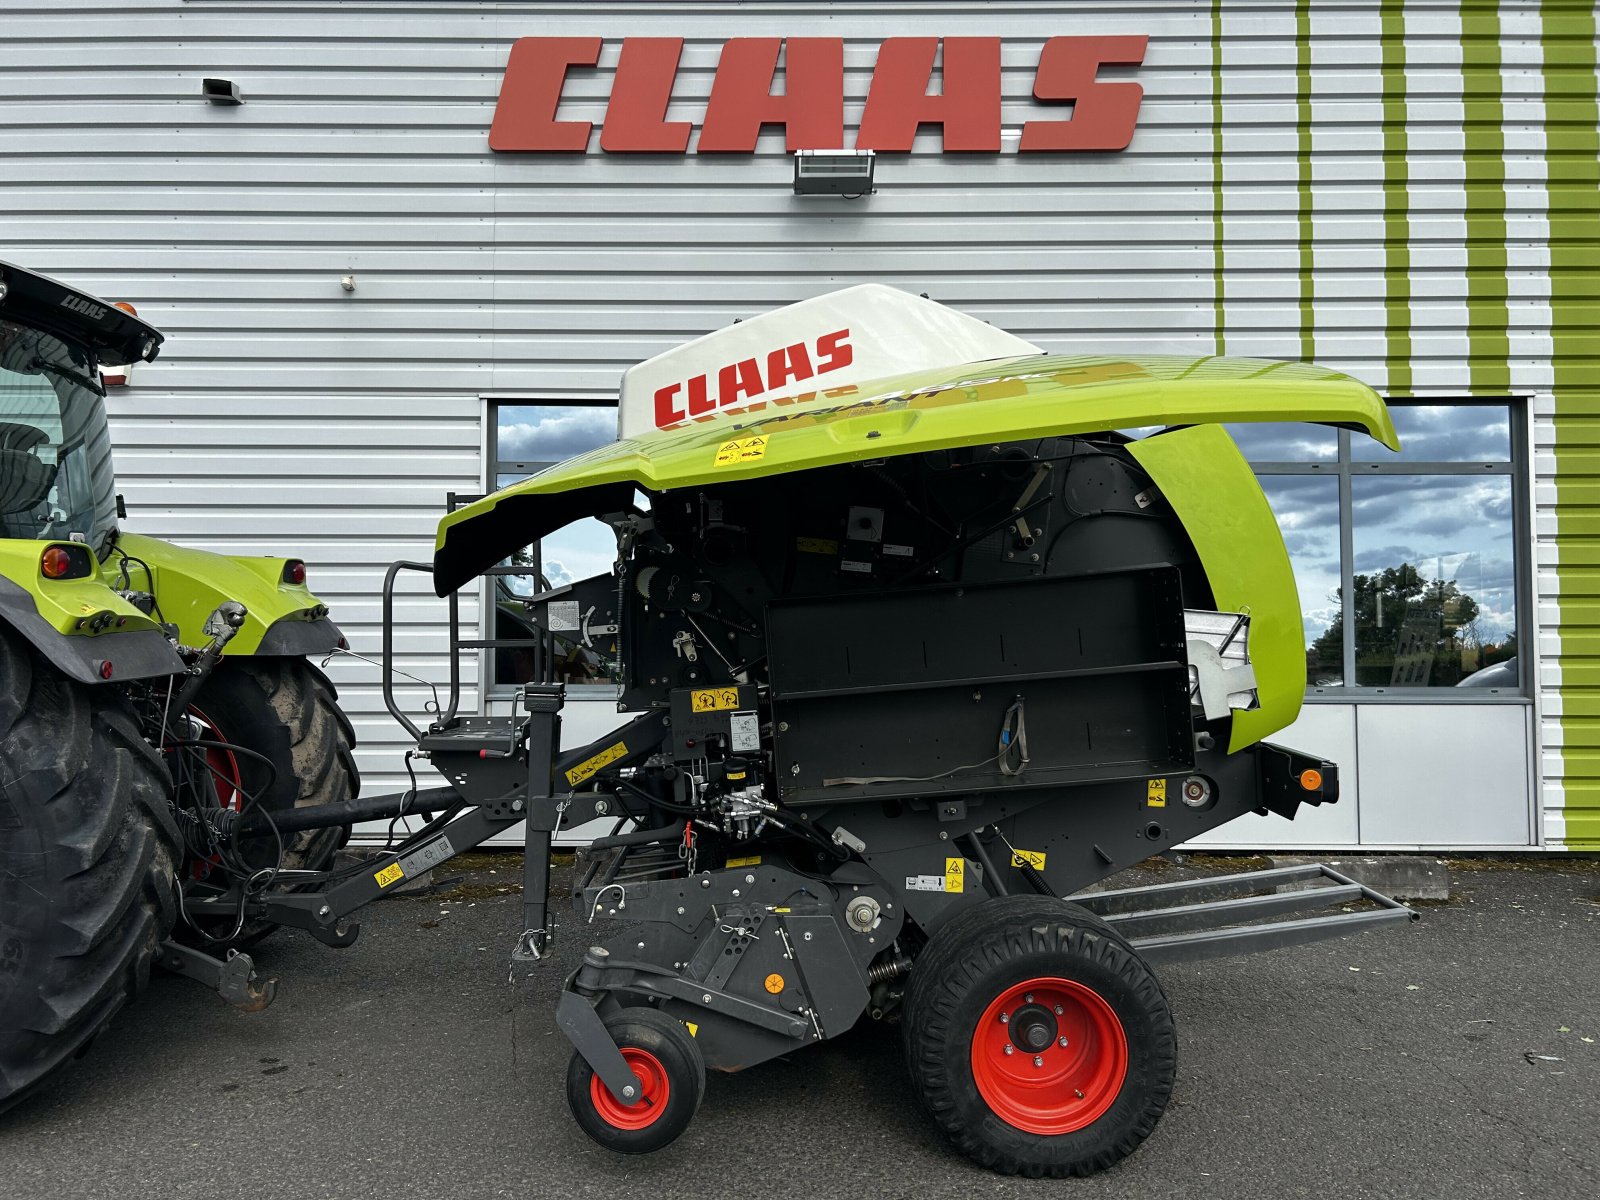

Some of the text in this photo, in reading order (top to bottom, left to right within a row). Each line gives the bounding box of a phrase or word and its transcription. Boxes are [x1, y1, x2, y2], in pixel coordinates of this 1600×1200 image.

[488, 35, 1149, 154] CLAAS
[60, 294, 108, 320] CLAAS
[654, 328, 853, 428] CLAAS
[733, 387, 956, 430] VARIANT
